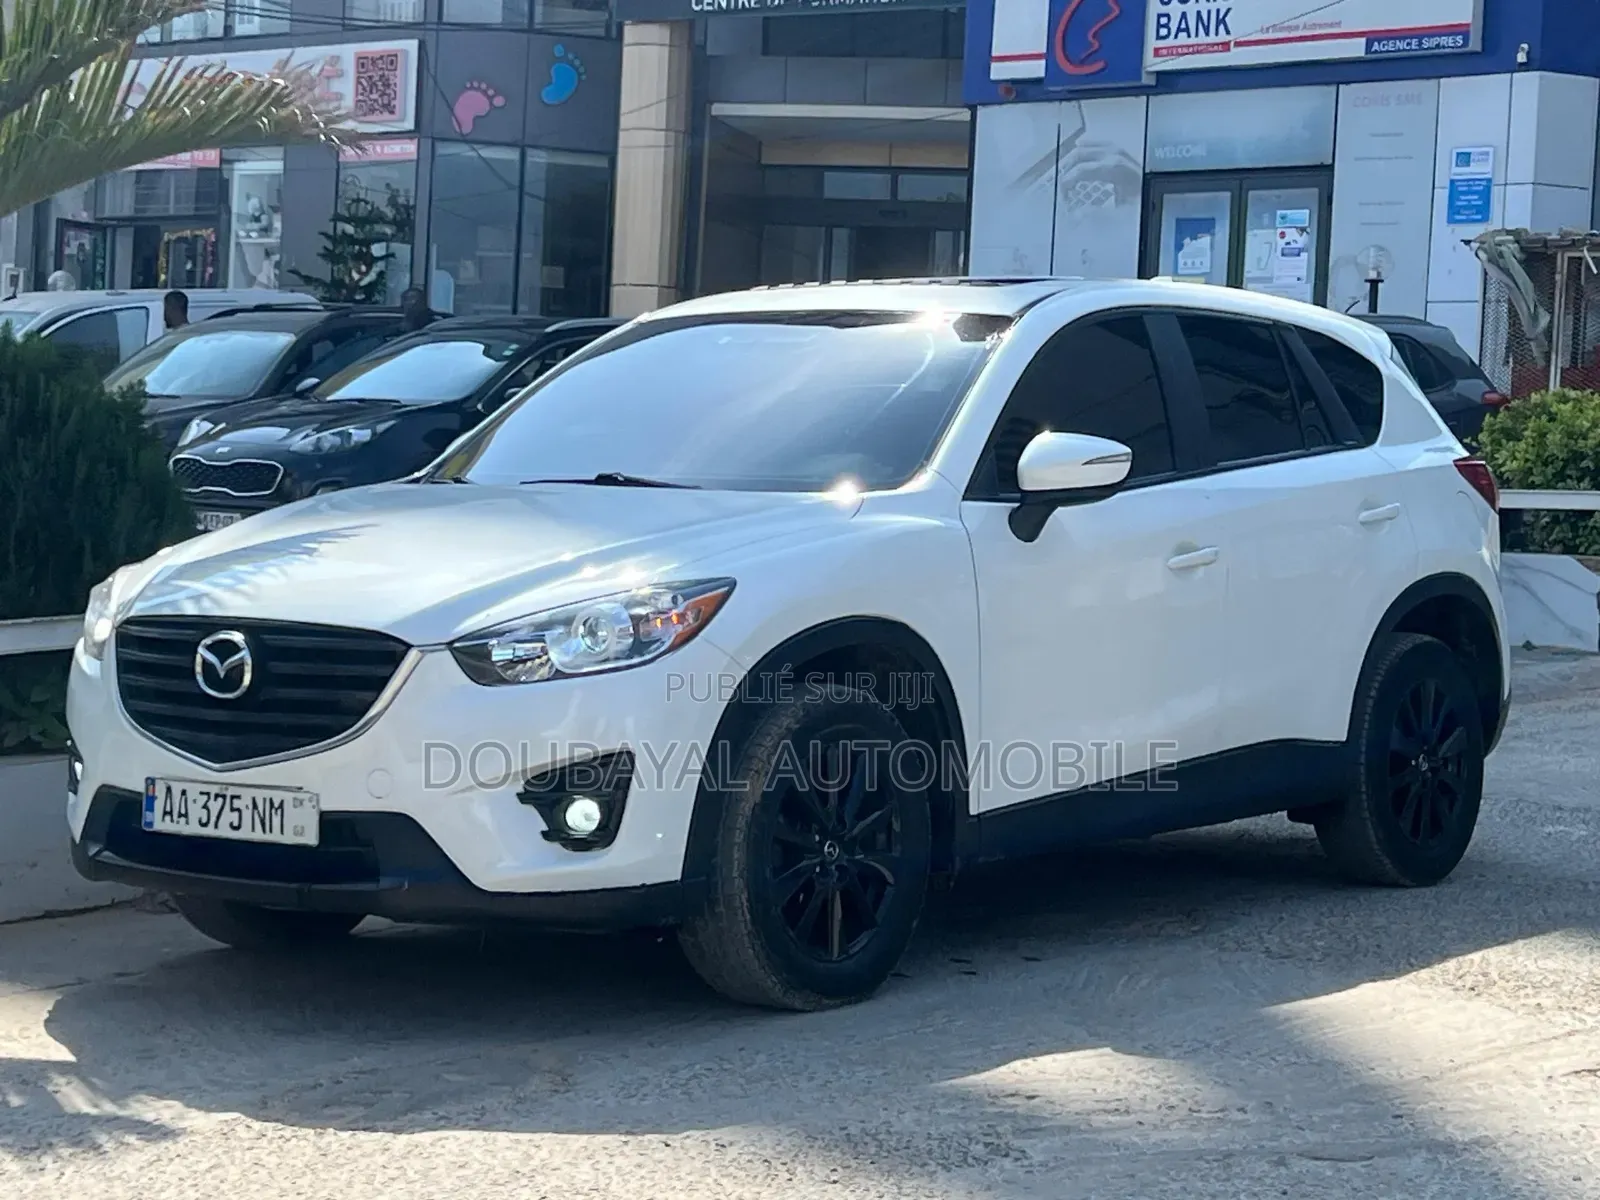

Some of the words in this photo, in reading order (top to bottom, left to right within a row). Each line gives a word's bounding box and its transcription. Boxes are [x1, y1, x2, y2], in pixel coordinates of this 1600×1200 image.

[1155, 7, 1233, 41] BANK
[1370, 39, 1420, 52] AGENCE
[1421, 34, 1464, 49] SIPRES
[1154, 142, 1207, 159] WELCO
[198, 791, 243, 832] 375
